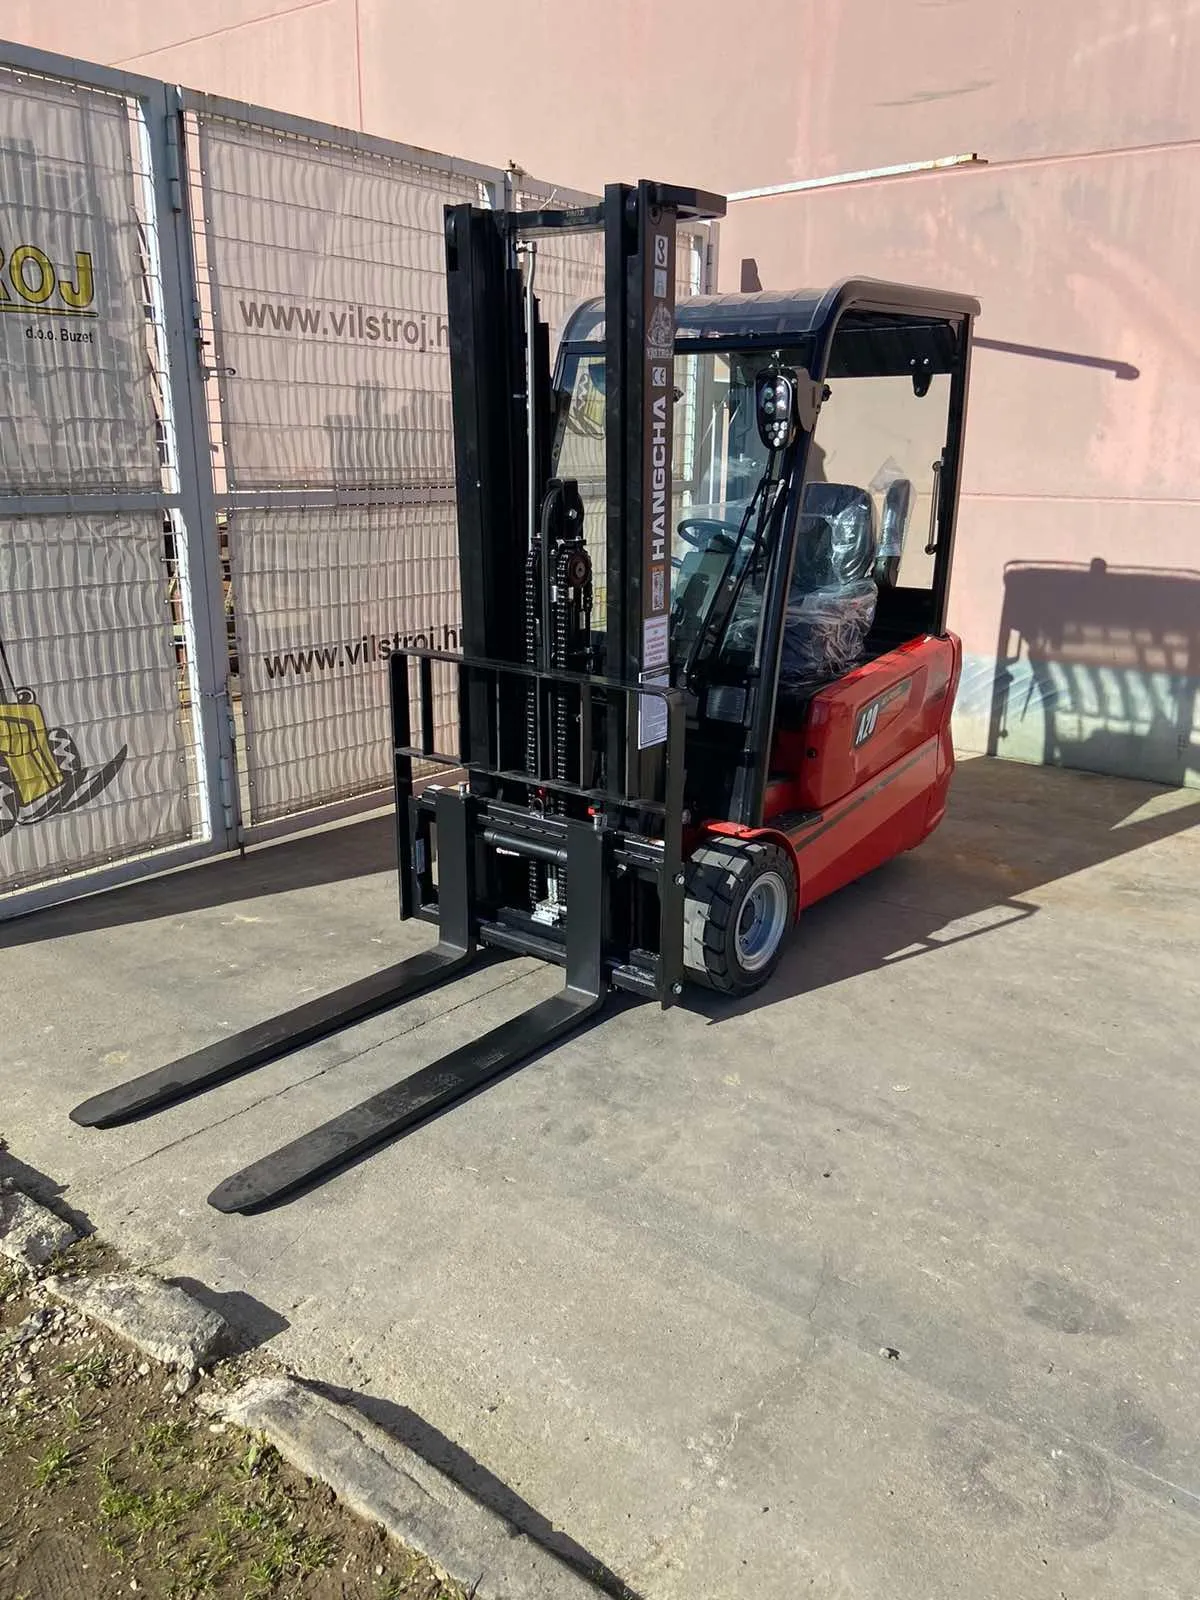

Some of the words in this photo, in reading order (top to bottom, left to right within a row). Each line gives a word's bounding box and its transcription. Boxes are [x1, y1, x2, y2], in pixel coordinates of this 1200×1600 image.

[25, 326, 58, 341] d.o.o.
[60, 328, 94, 343] Buzet
[652, 395, 667, 561] HANGCHA
